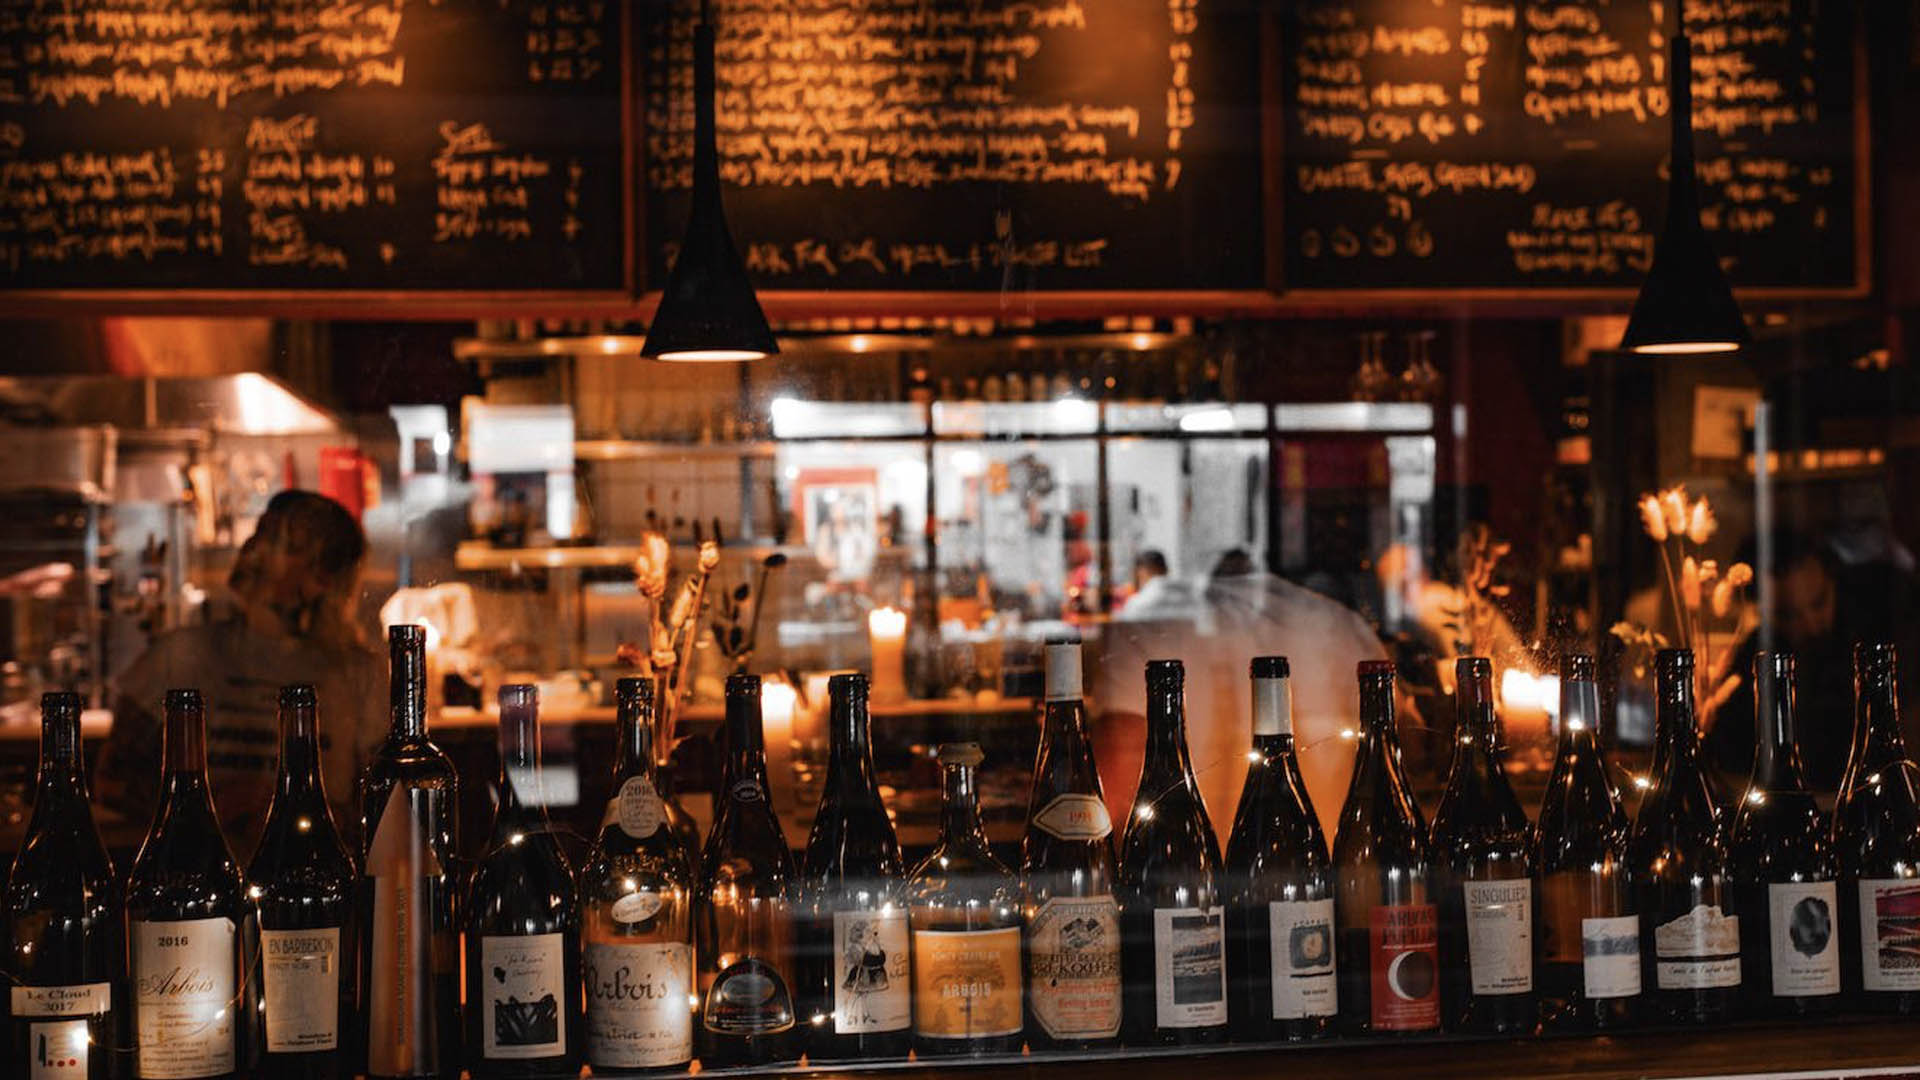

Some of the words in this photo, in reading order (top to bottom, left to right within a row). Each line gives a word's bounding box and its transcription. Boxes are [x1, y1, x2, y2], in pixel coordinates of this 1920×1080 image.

[158, 936, 189, 948] 2016
[140, 966, 214, 996] Arbois
[26, 990, 44, 1000] Le
[48, 988, 91, 1000] Cloud
[943, 983, 991, 999] ARBOIS
